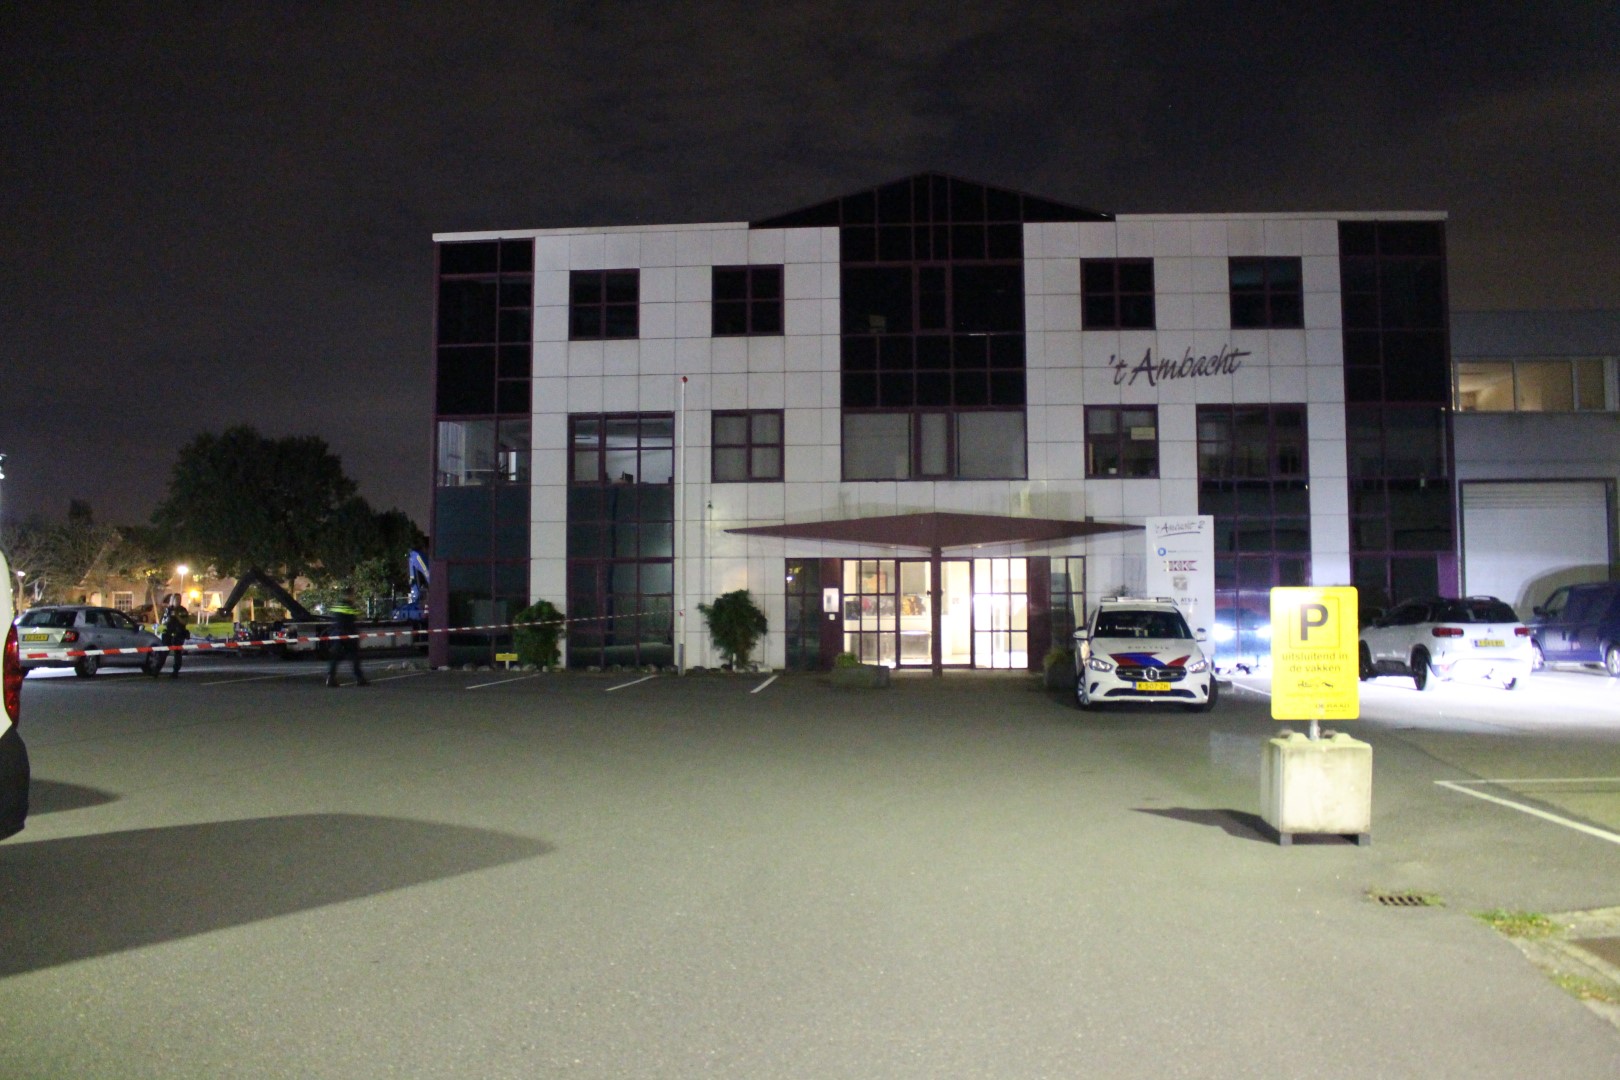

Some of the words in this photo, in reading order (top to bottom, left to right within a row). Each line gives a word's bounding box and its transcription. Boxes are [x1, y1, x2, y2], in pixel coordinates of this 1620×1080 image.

[1108, 354, 1128, 385] 't
[1128, 344, 1252, 387] Ambacht
[1301, 604, 1329, 641] P
[1282, 652, 1336, 661] uitsluitend
[1339, 653, 1349, 661] in
[1289, 664, 1302, 673] de
[1305, 664, 1341, 672] vakken
